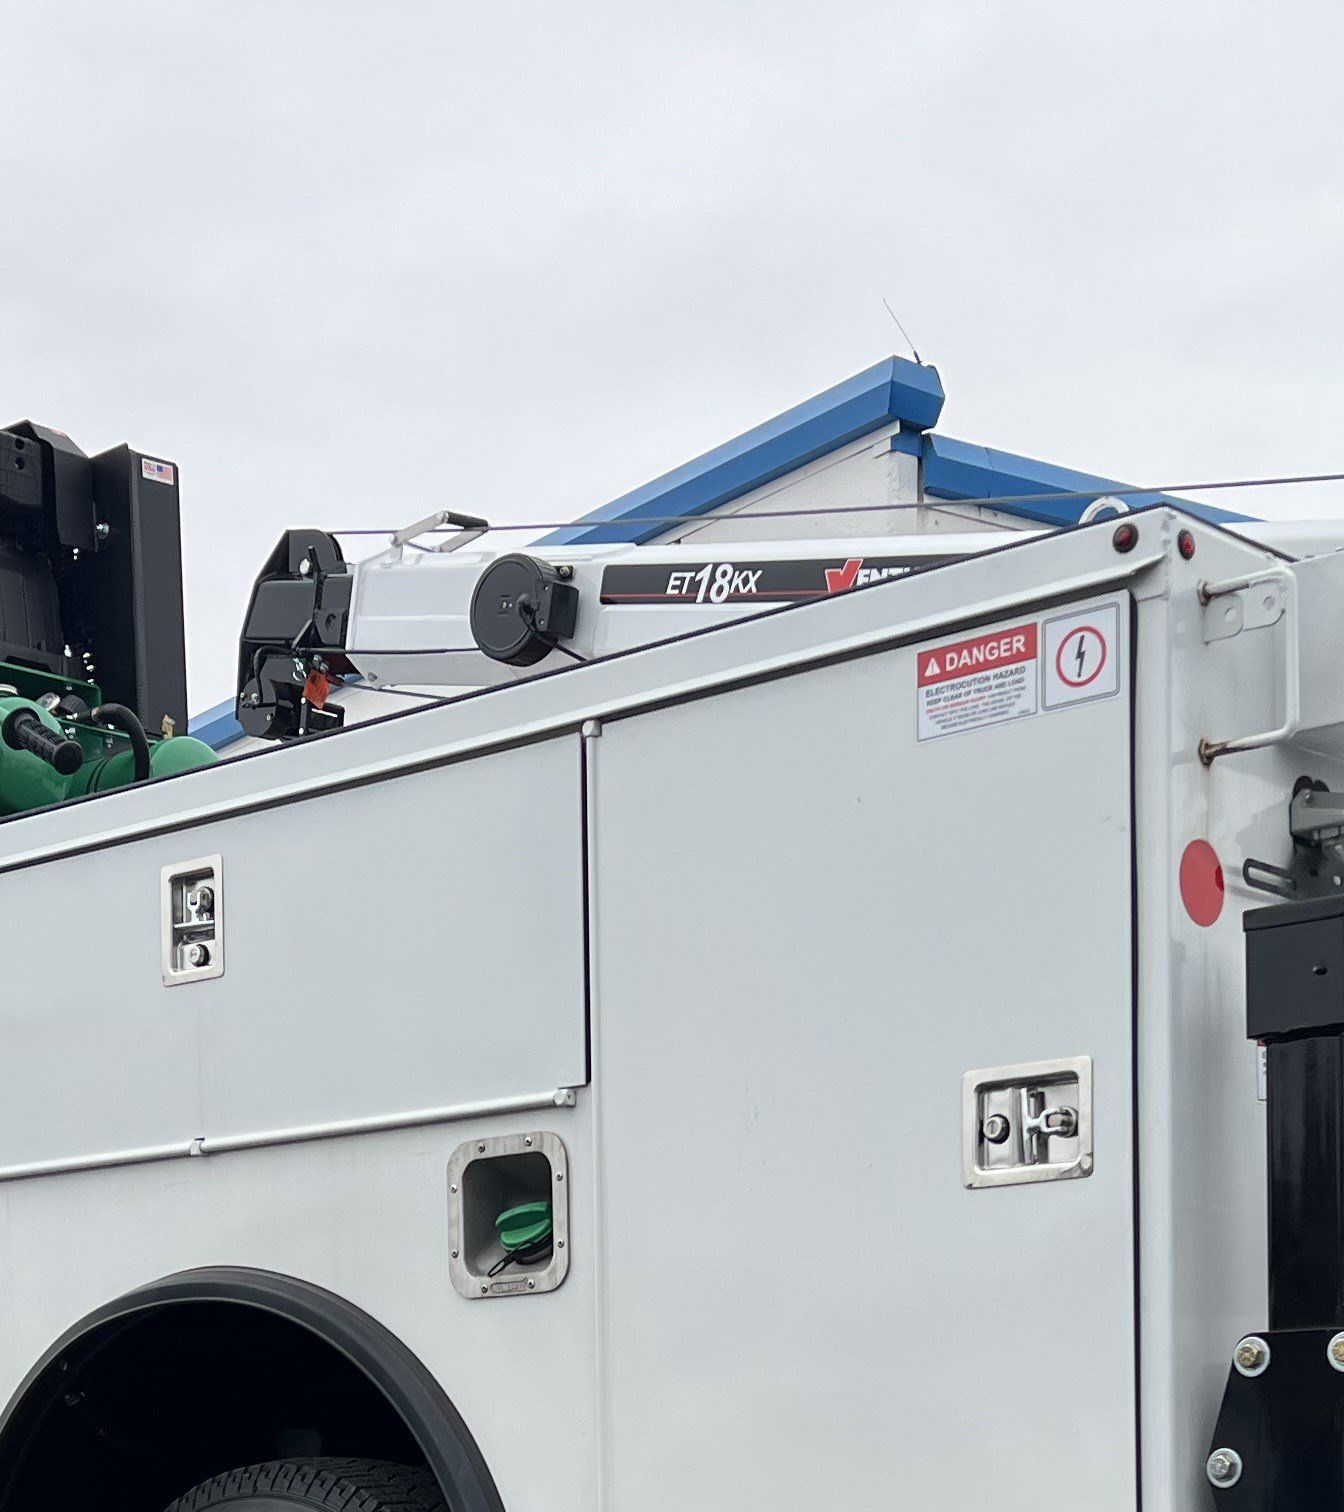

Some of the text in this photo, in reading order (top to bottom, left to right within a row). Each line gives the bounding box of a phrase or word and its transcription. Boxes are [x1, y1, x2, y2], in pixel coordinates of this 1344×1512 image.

[945, 634, 1026, 671] DANGER
[925, 674, 991, 698] ELECTROCUTION
[992, 665, 1027, 681] HAZARD
